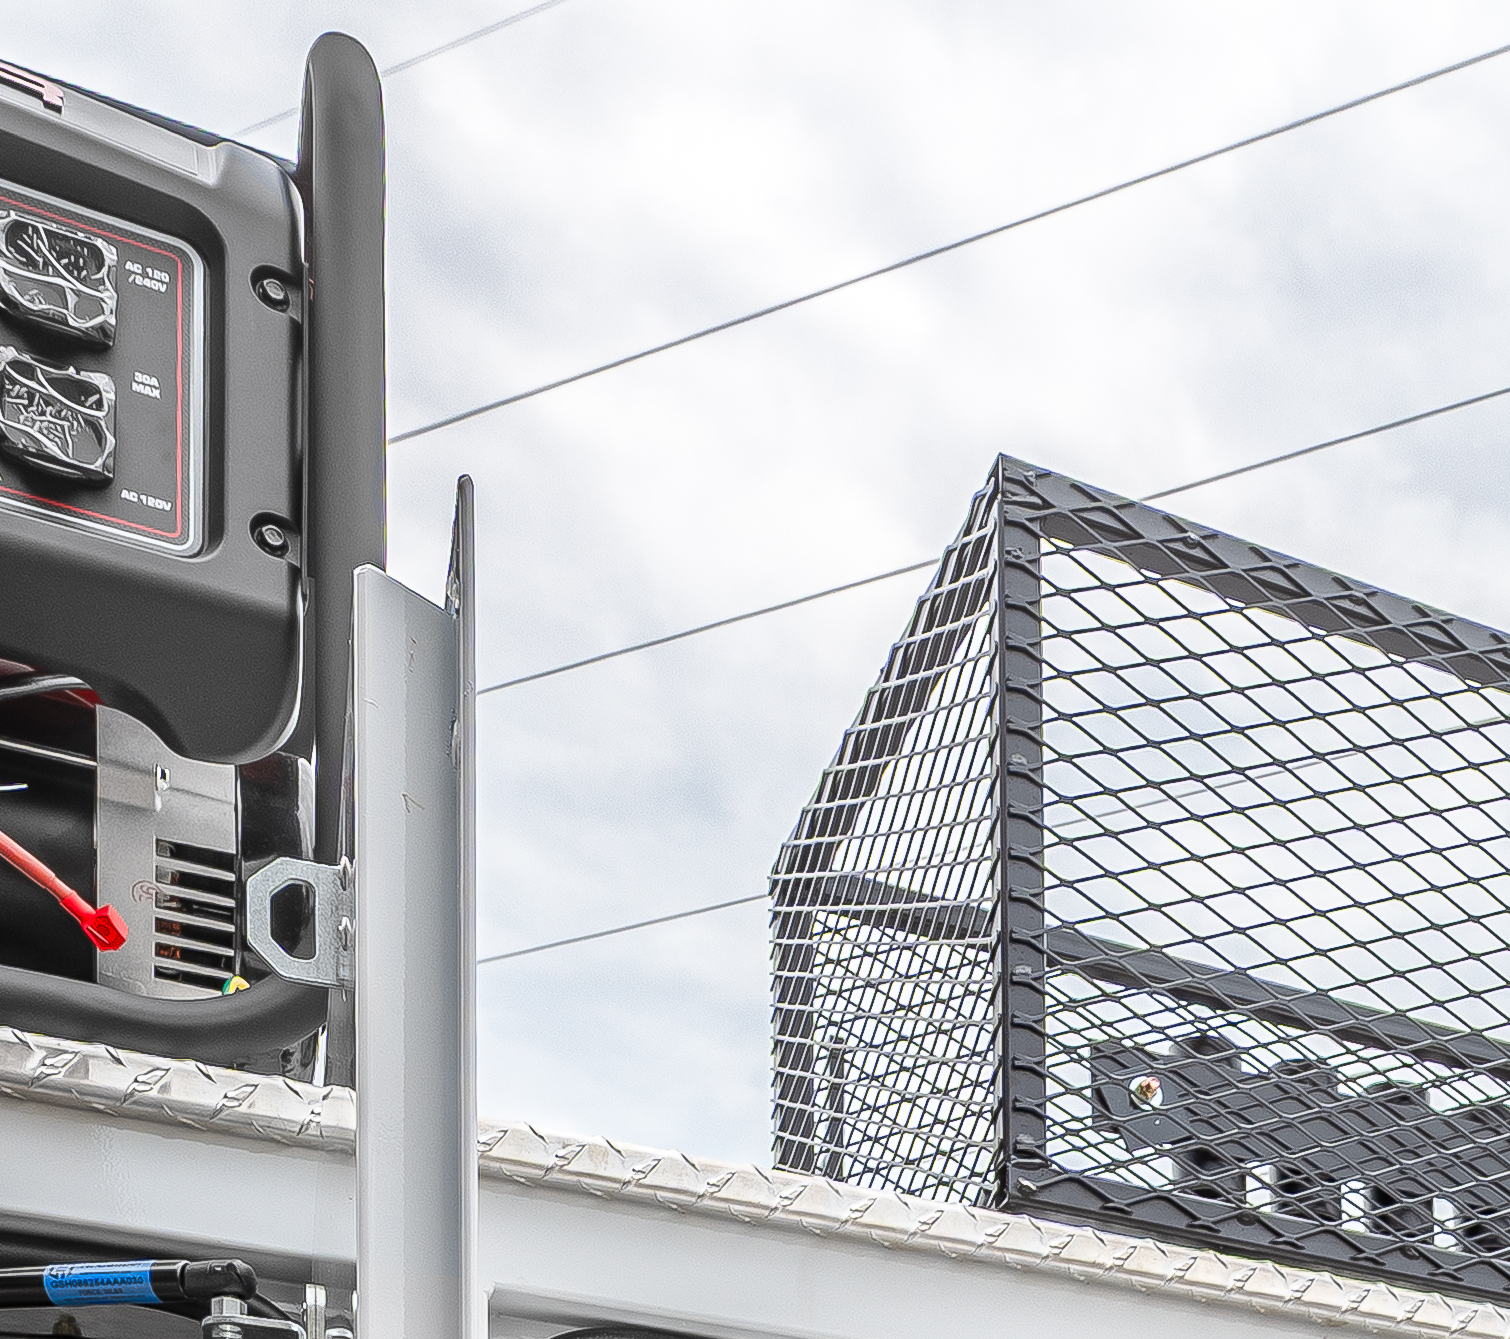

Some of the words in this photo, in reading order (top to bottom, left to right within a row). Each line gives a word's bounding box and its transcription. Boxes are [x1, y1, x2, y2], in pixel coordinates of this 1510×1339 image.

[133, 371, 160, 388] 30A
[131, 381, 161, 399] MAX
[140, 492, 173, 511] 120V
